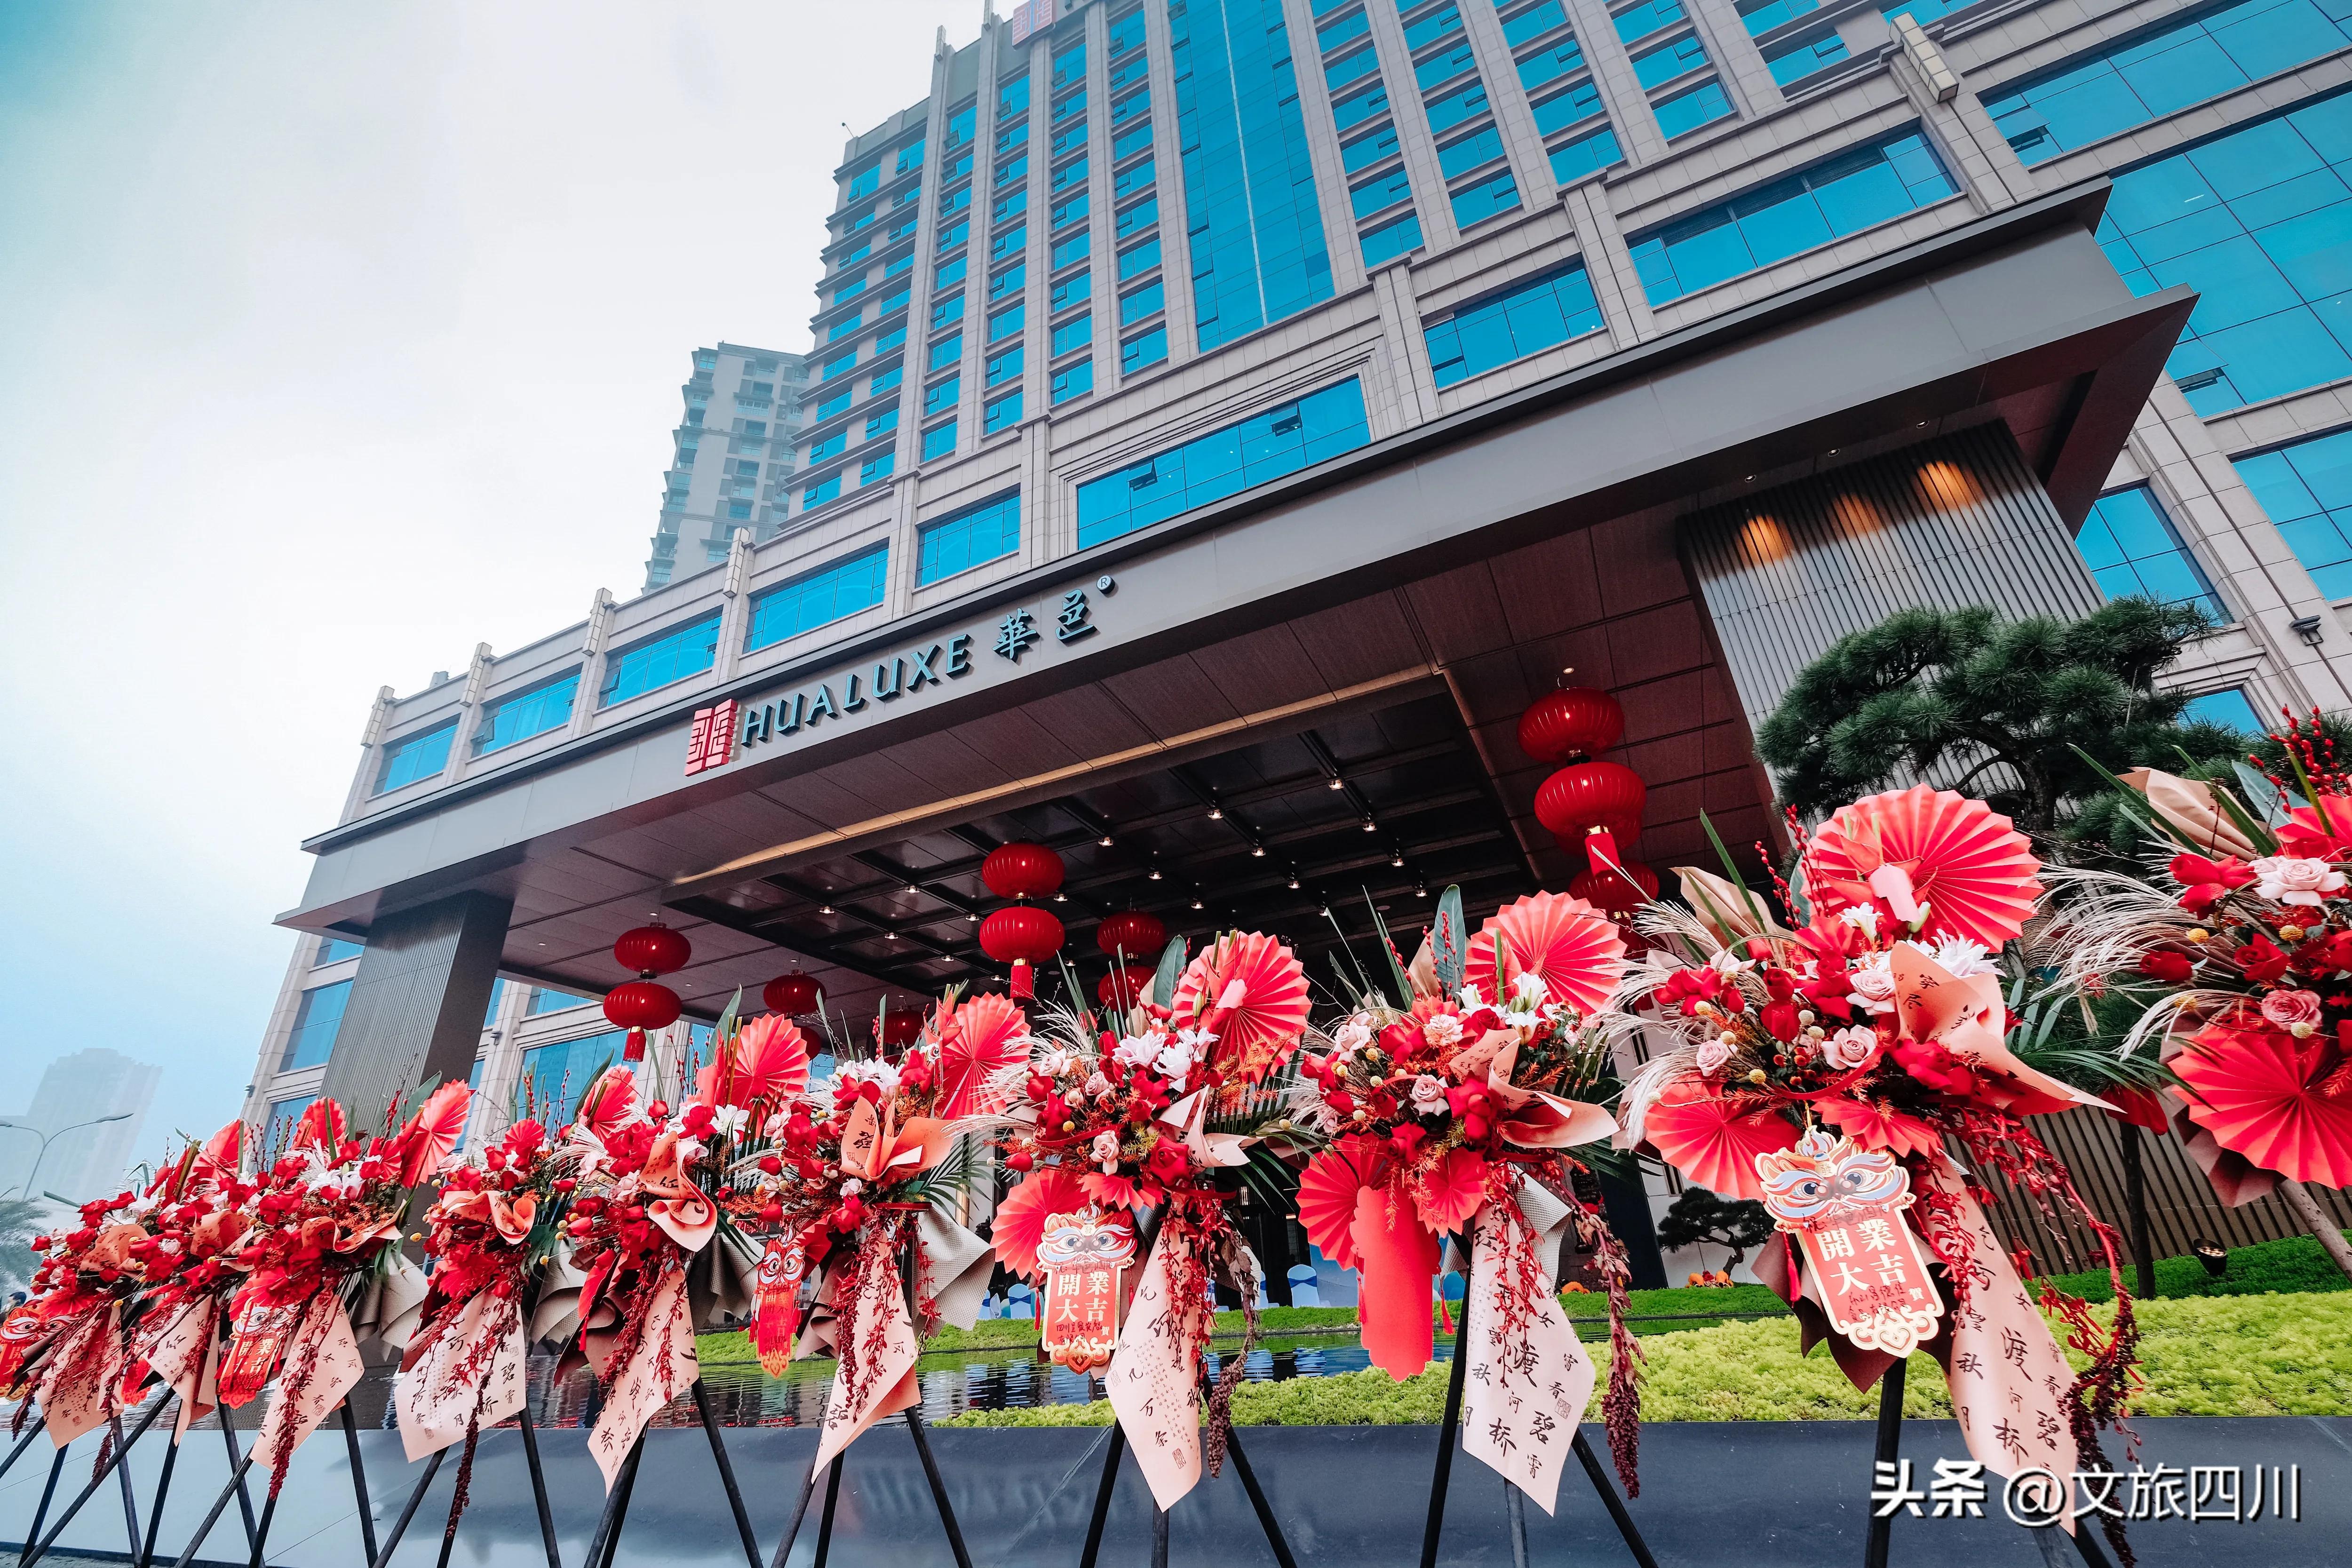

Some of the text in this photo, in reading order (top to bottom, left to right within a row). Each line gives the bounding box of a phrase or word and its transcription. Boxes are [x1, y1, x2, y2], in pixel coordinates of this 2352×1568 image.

[740, 633, 972, 747] HUALUXE
[992, 589, 1097, 661] 華邑
[1814, 1218, 1897, 1262] 開業
[1057, 1271, 1110, 1297] 開業
[1829, 1254, 1906, 1296] 大吉
[1054, 1298, 1107, 1323] 大吉
